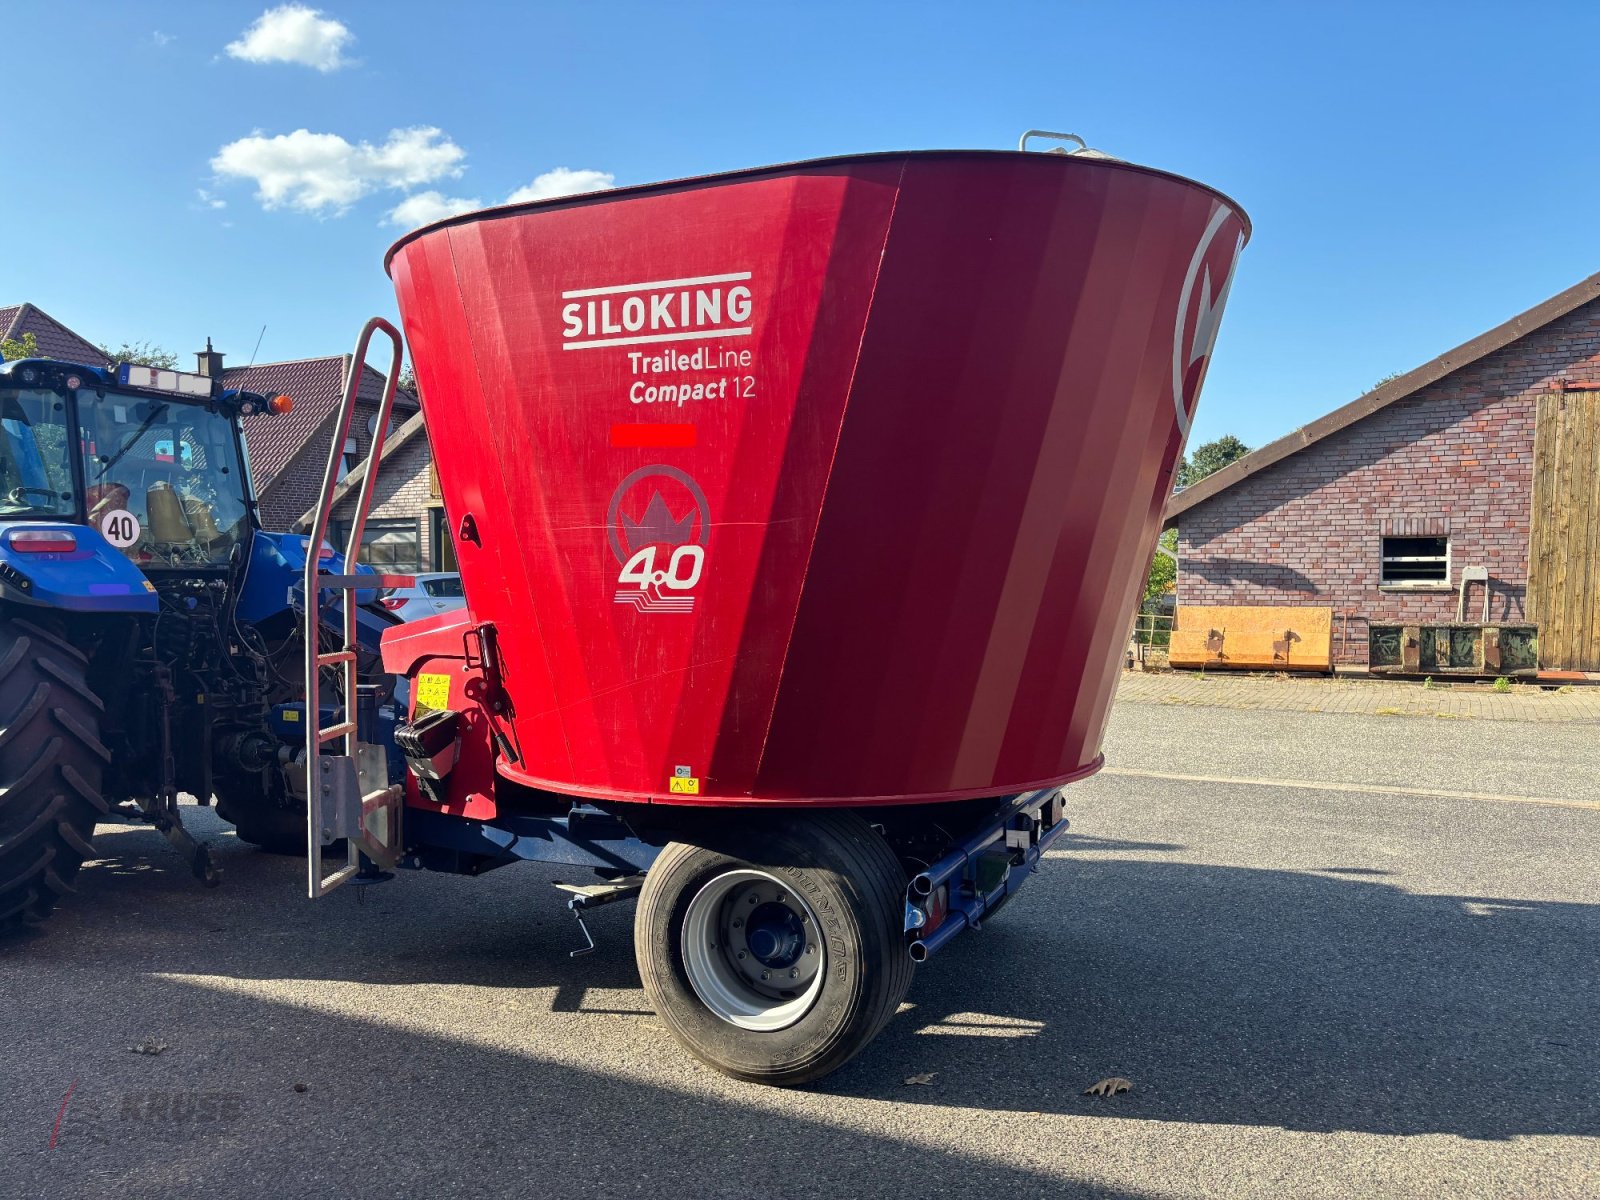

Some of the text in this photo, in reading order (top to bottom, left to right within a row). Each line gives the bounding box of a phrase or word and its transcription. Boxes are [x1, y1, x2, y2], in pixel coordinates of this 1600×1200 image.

[562, 286, 752, 338] SILOKING
[628, 346, 752, 374] TrailedLine
[629, 376, 756, 407] Compact 12
[107, 516, 133, 541] 40
[618, 545, 705, 590] 4.0
